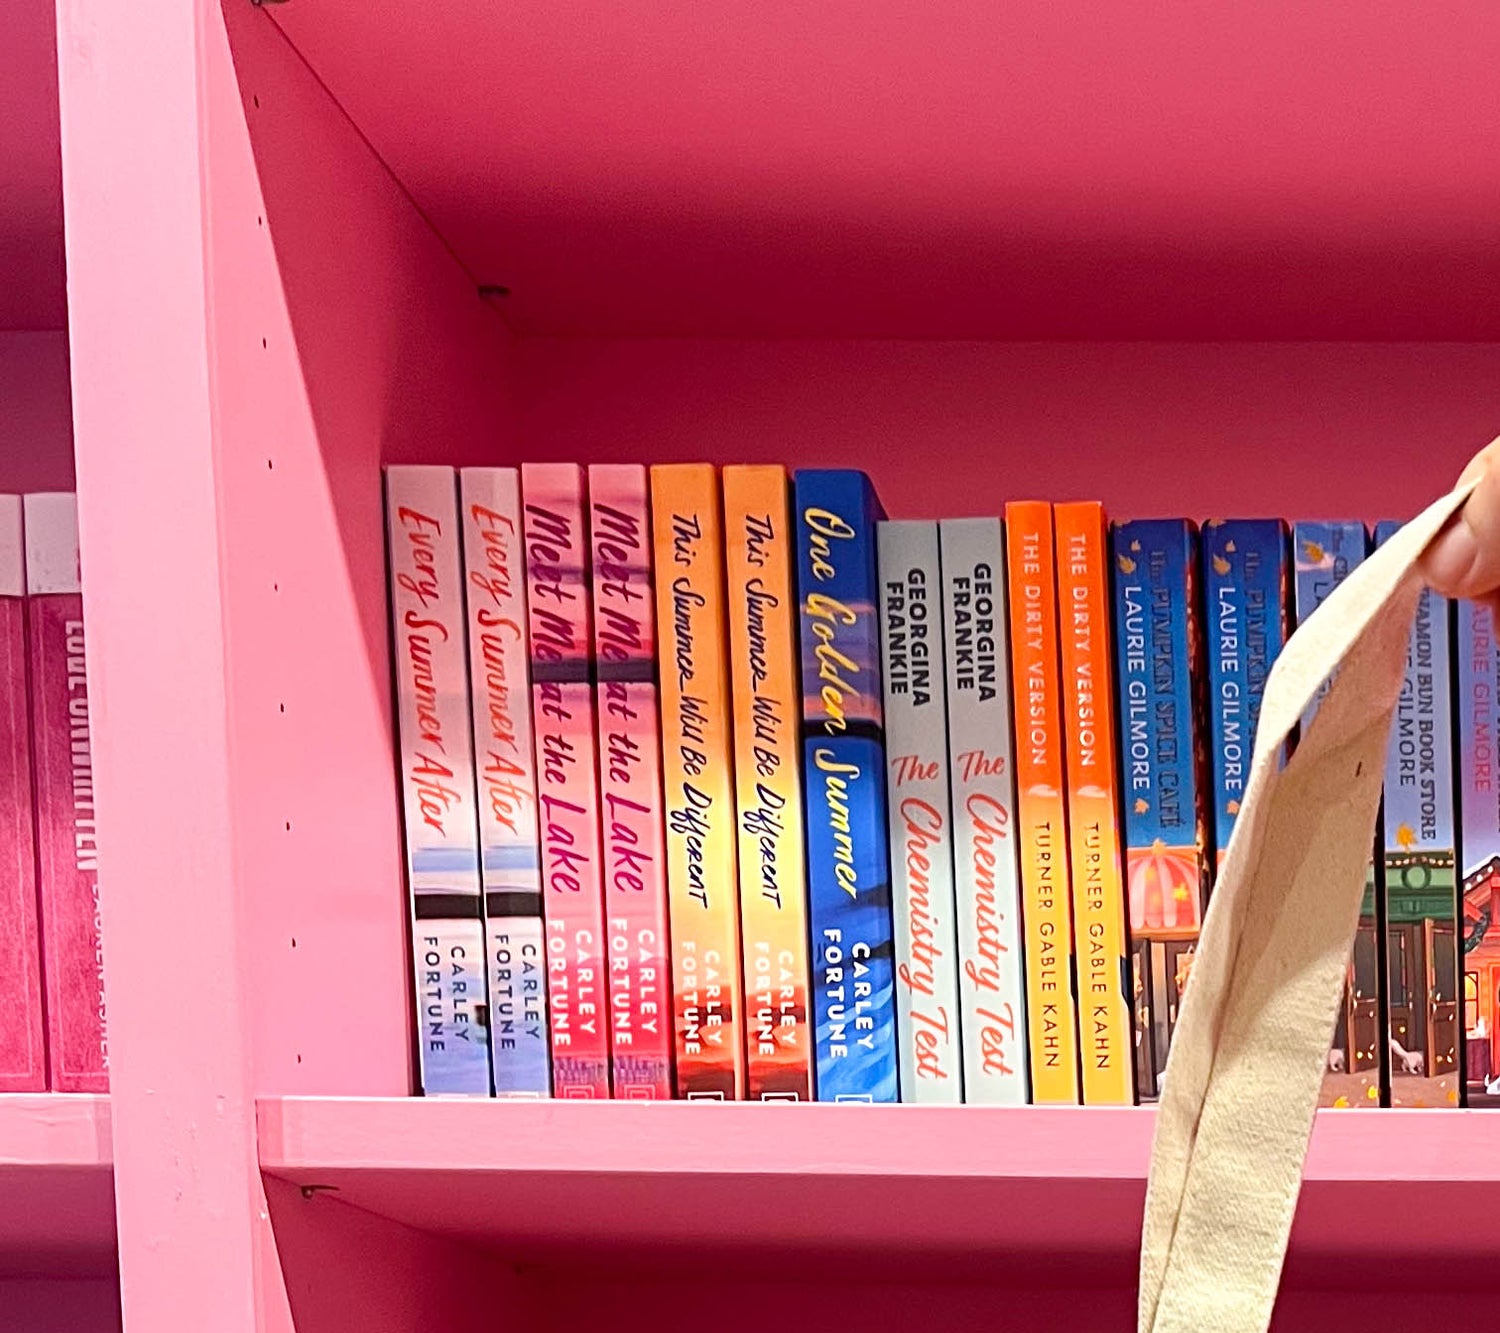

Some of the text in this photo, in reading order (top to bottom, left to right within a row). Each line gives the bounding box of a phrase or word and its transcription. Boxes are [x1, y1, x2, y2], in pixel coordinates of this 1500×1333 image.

[398, 505, 461, 839] Every Summer After
[525, 504, 590, 894] Meet Me at the Lake
[804, 506, 859, 900] One Golden Summer
[886, 582, 908, 695] FRANKIE
[908, 568, 930, 706] GEORGINA
[1024, 532, 1047, 766] THE DIRTY VERSION
[1125, 586, 1150, 790] LAURIE GILMORE
[1419, 719, 1434, 775] BOOK
[1422, 777, 1436, 840] STORE
[824, 929, 847, 1059] FORTUNE
[851, 942, 874, 1050] CARLEY
[892, 755, 948, 1078] The Chemistry Test
[1036, 821, 1059, 1068] TURNER GABLE KAHN
